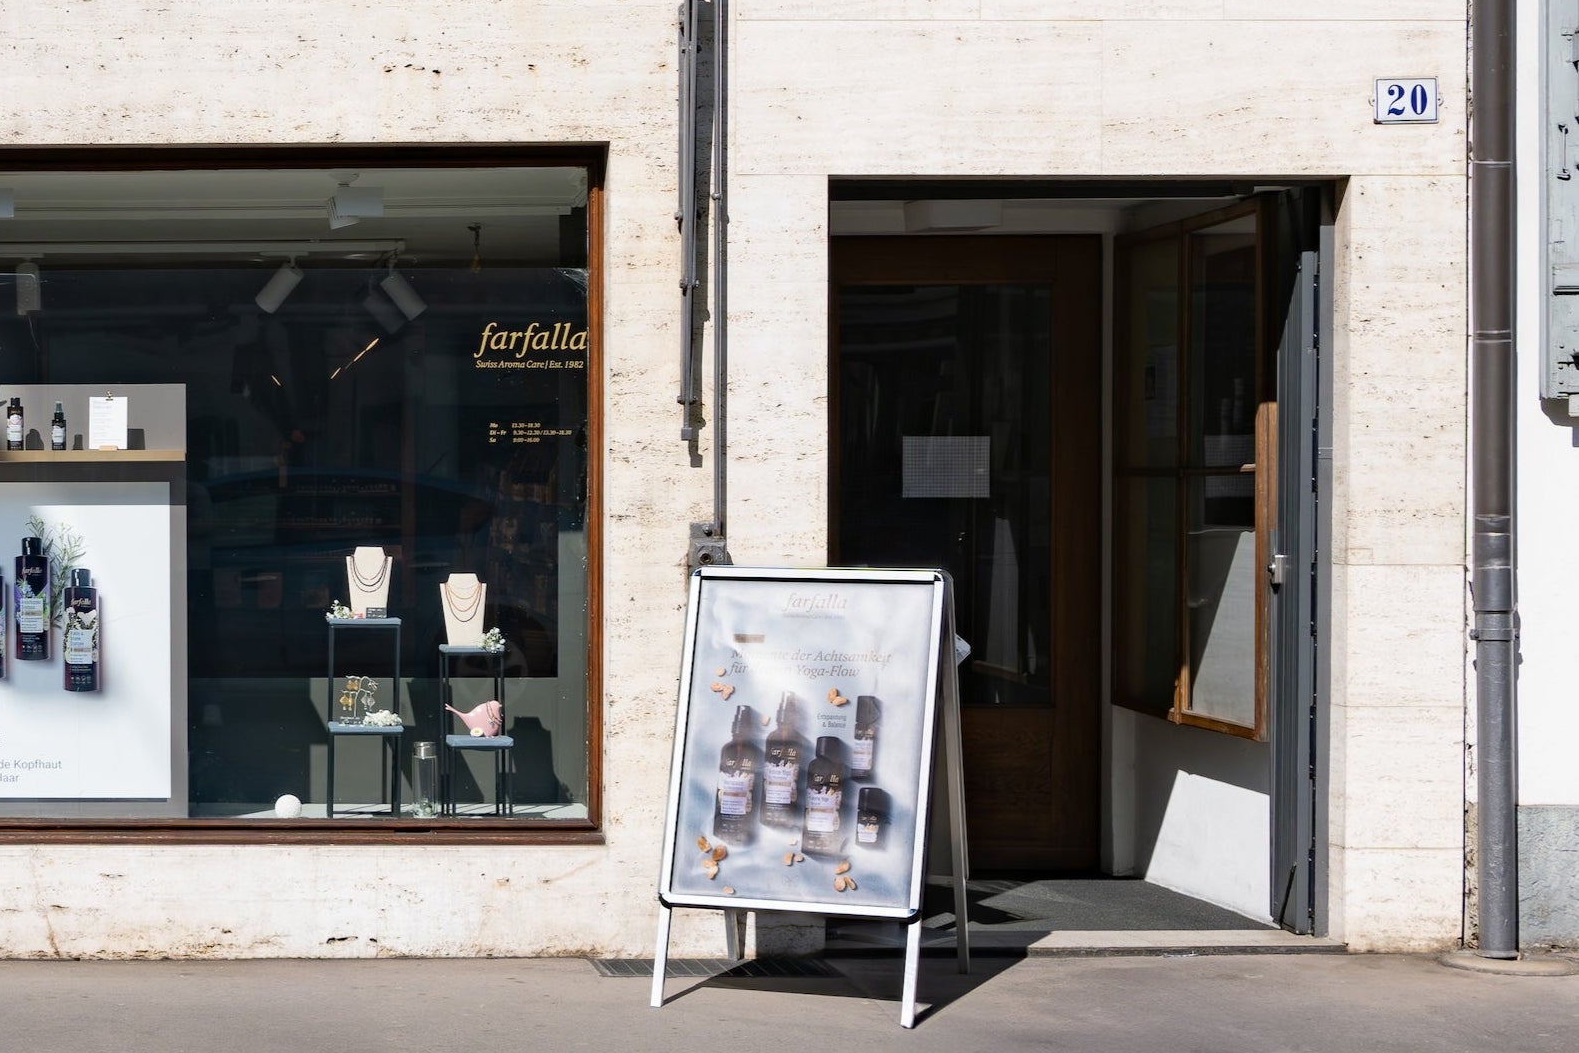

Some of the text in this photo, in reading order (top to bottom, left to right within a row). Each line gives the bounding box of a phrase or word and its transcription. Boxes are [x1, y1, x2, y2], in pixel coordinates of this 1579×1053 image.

[1387, 84, 1428, 116] 20
[473, 322, 588, 359] farfalla
[475, 360, 498, 369] Swiss
[498, 360, 525, 369] Aroma
[526, 360, 545, 369] Care
[549, 361, 563, 369] Est.
[565, 361, 584, 369] 1982
[783, 593, 848, 612] farfalla
[791, 648, 812, 661] der
[813, 650, 893, 664] Achtsamkeit
[729, 662, 749, 676] für
[796, 664, 861, 678] Yoga-Flow
[14, 759, 62, 771] Kopfhaut
